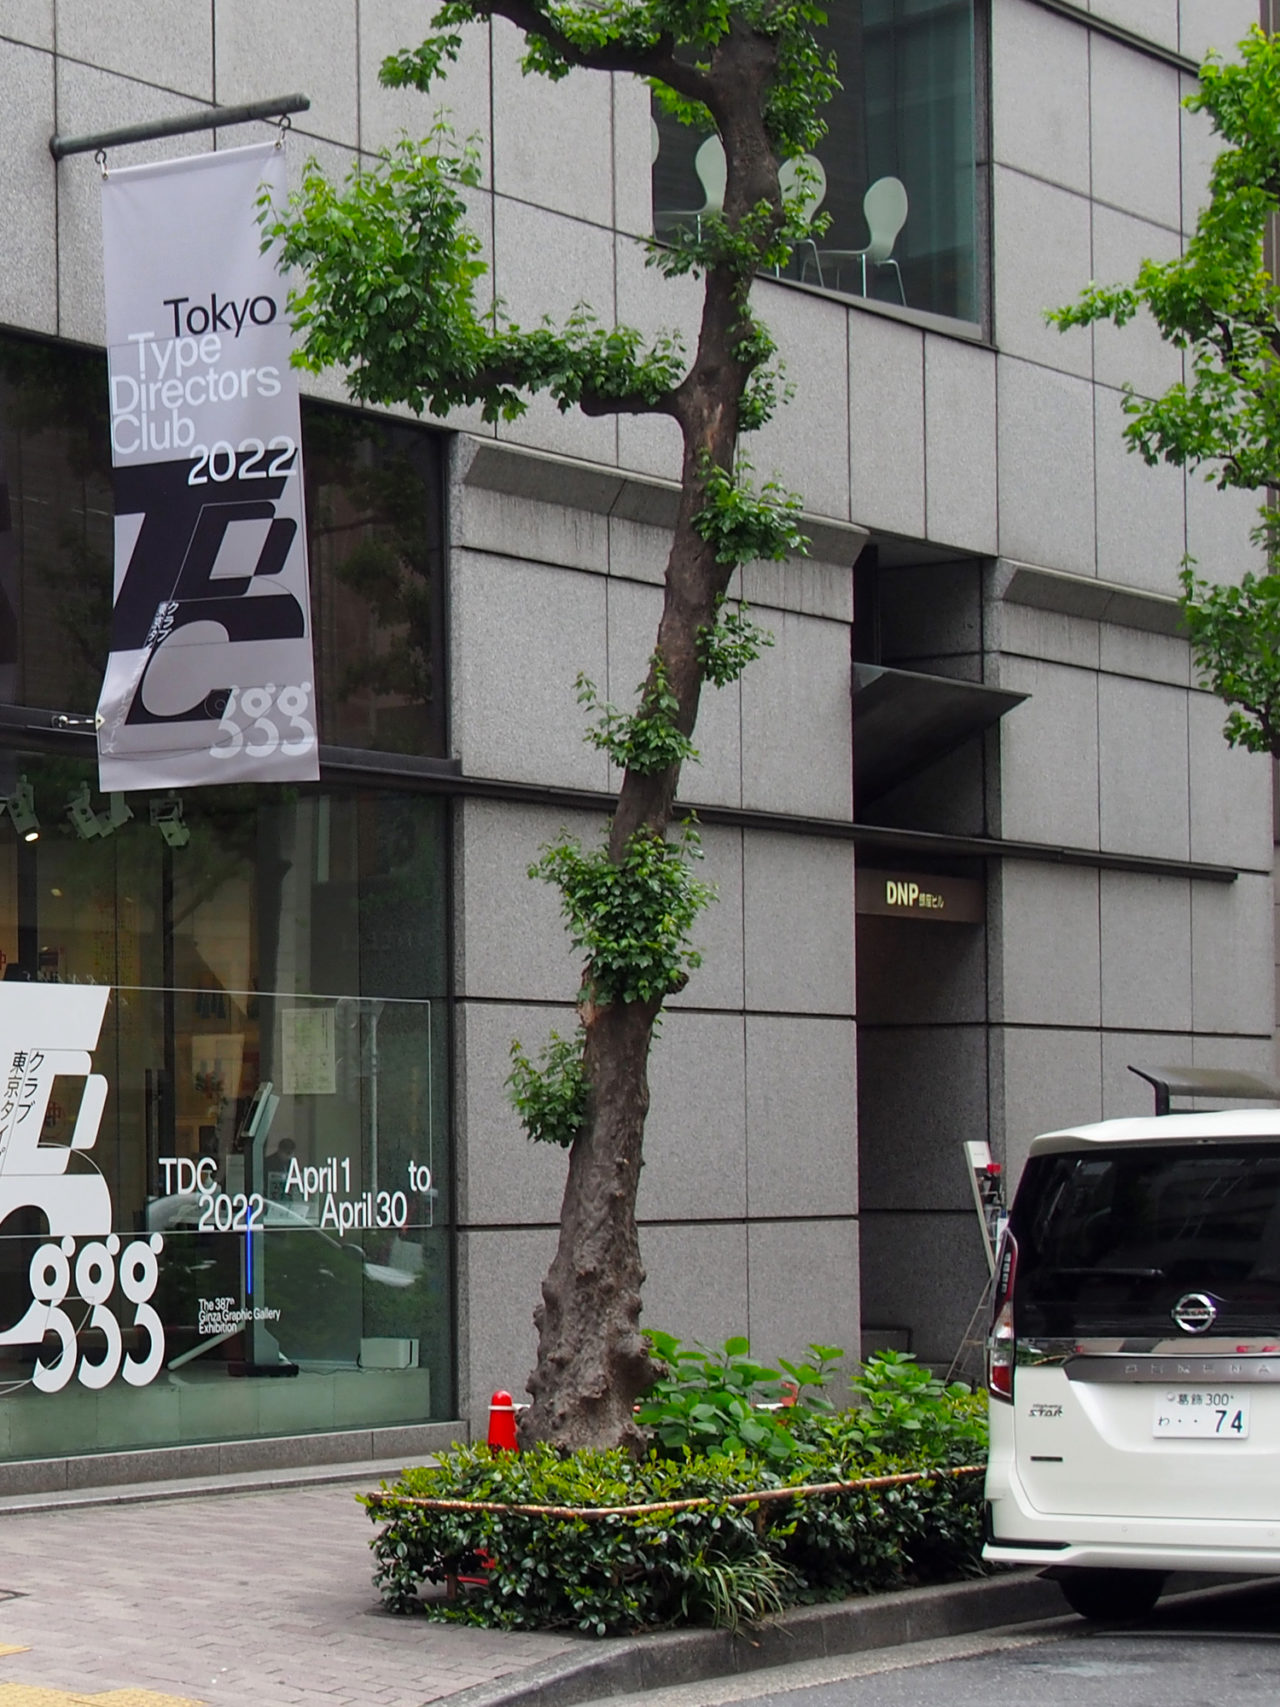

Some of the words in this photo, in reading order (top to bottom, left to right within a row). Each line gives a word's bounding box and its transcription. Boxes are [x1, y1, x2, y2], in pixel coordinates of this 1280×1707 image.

[164, 293, 277, 338] Tokyo
[128, 331, 221, 379] Type
[111, 366, 281, 415] Directors
[112, 408, 195, 454] Club
[188, 435, 298, 485] 2022
[886, 881, 918, 906] DNP
[17, 1051, 45, 1124] クラブ
[159, 1157, 218, 1195] TDC
[285, 1157, 337, 1201] April
[408, 1160, 430, 1192] to
[198, 1193, 264, 1231] 2022
[321, 1192, 371, 1236] April
[376, 1191, 407, 1228] 30
[29, 1232, 165, 1393] ggg
[198, 1298, 214, 1311] The
[198, 1310, 221, 1322] Ginza
[222, 1308, 252, 1323] Graphic
[253, 1307, 280, 1321] Gallery
[199, 1321, 237, 1334] Exhibition
[1158, 1416, 1170, 1426] わ
[1206, 1394, 1229, 1406] 300
